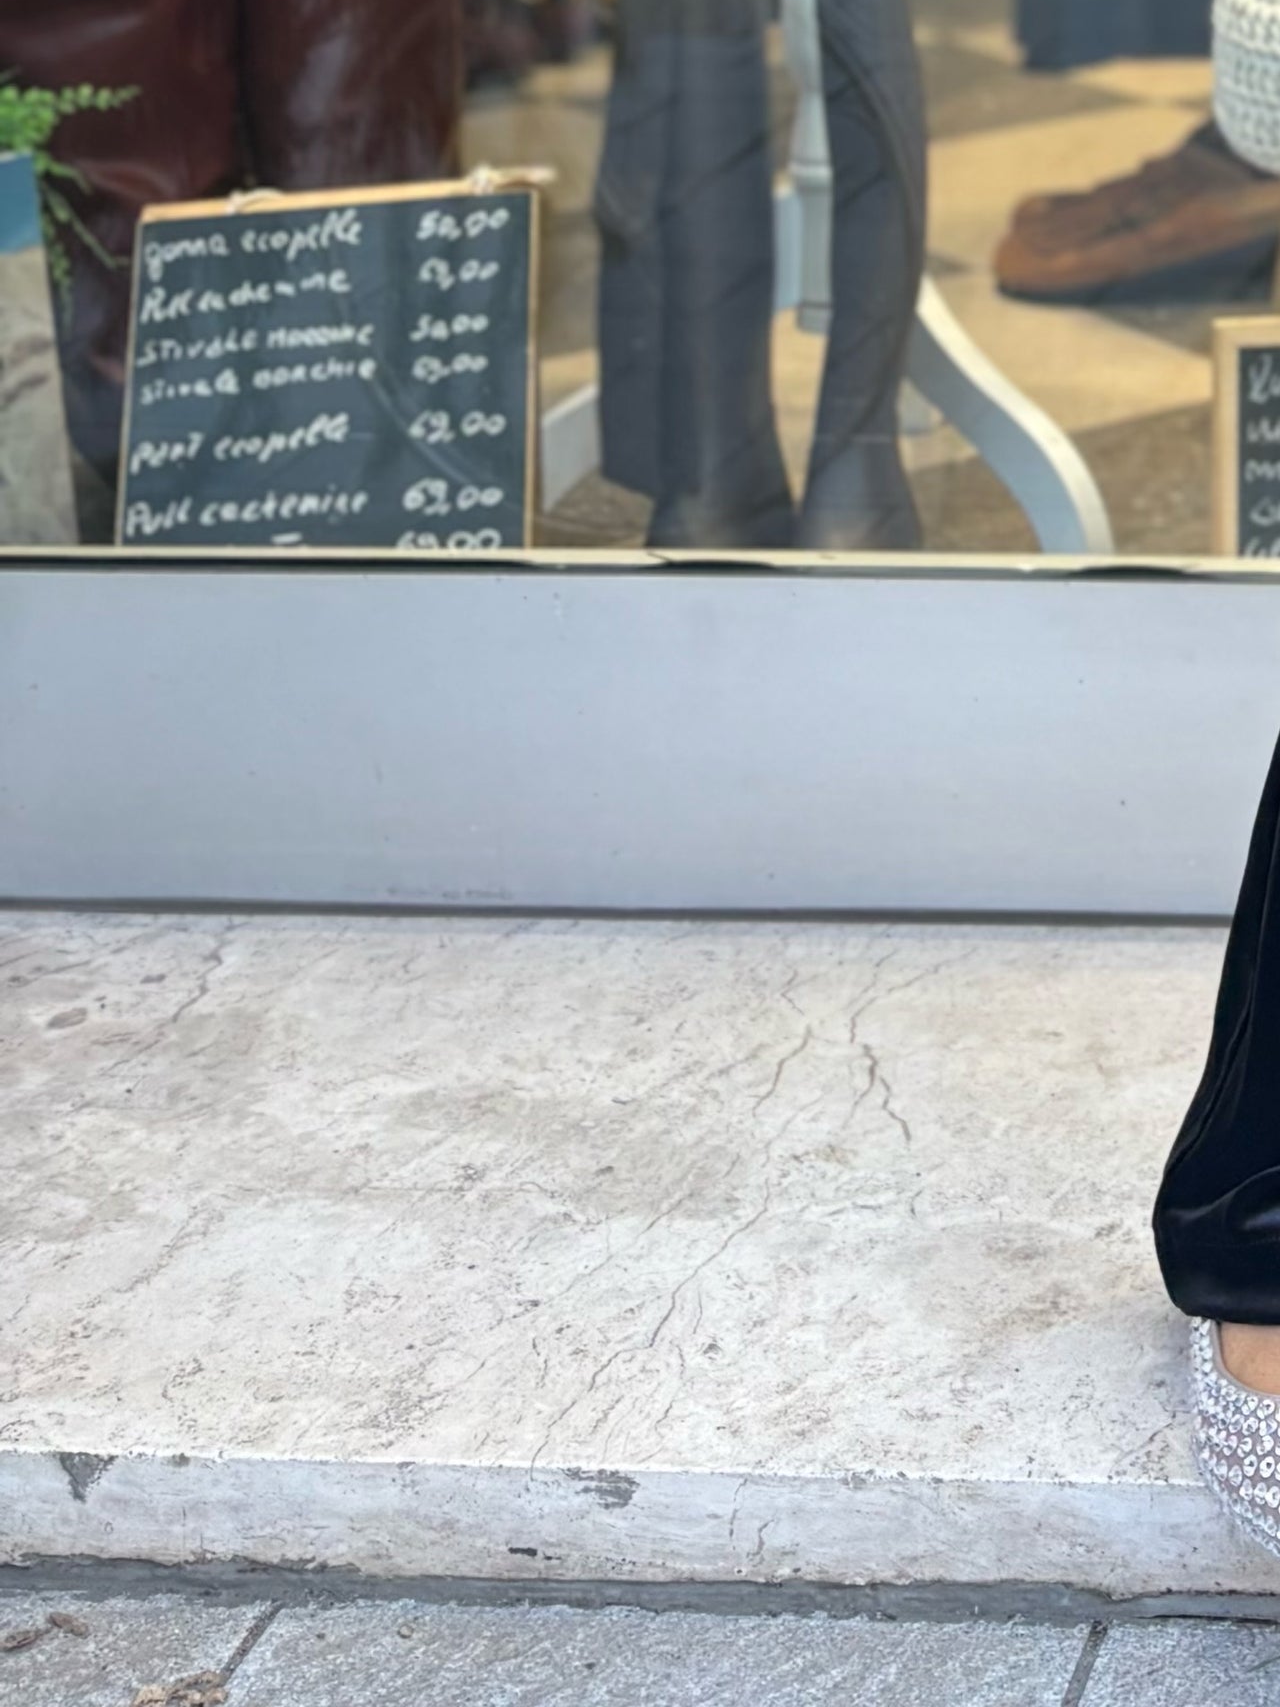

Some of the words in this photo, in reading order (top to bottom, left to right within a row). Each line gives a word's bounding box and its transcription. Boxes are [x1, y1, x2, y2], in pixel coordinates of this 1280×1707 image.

[241, 207, 363, 262] ecopelle
[408, 409, 507, 445] 69,00
[125, 495, 193, 538] Pull
[402, 476, 505, 517] 69,00
